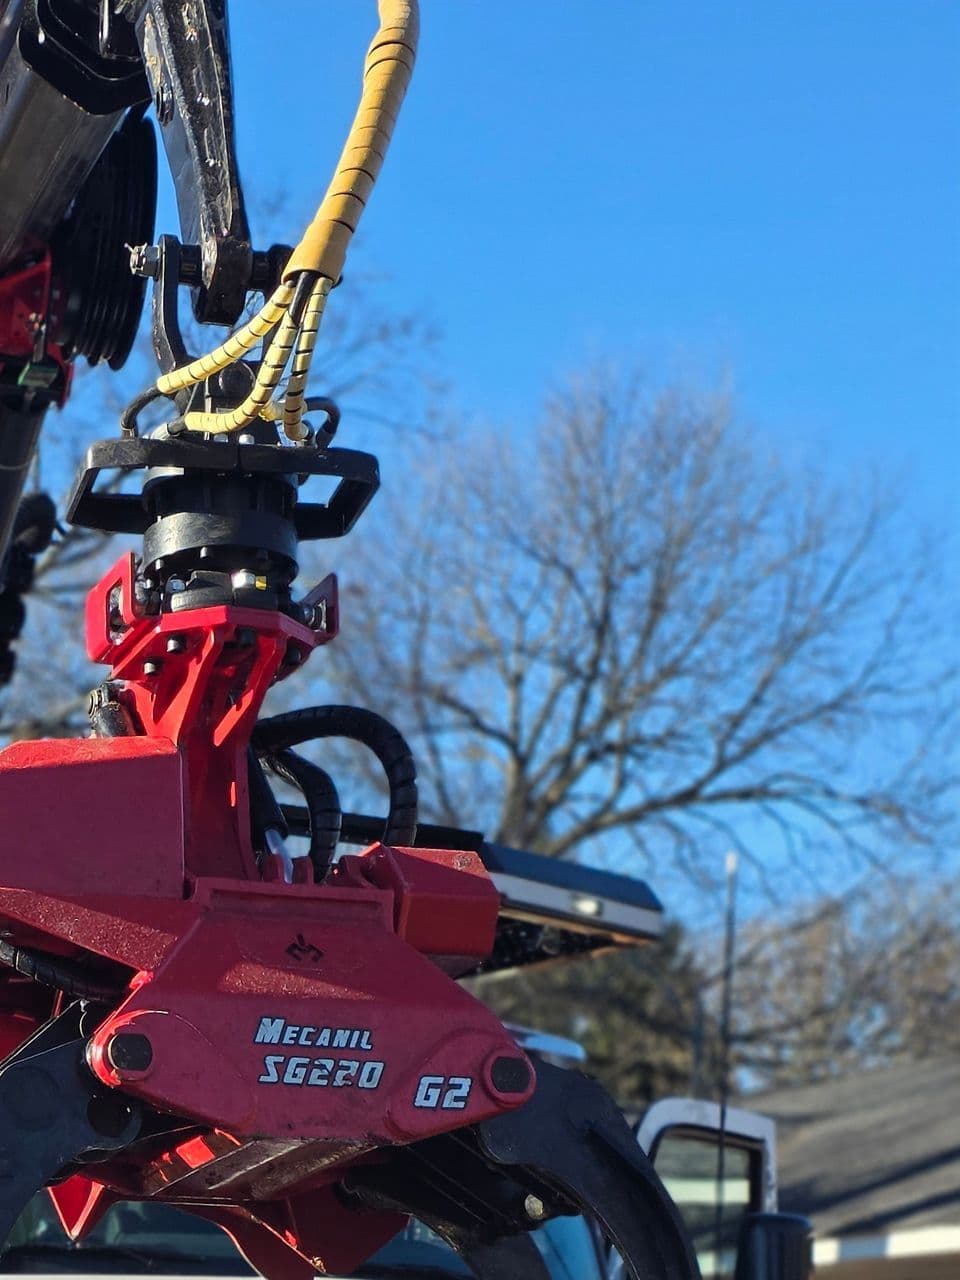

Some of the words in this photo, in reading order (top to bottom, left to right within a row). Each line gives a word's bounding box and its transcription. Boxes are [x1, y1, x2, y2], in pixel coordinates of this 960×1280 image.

[255, 1016, 374, 1050] MECANIL
[258, 1055, 386, 1089] SG220
[414, 1075, 473, 1110] G2
